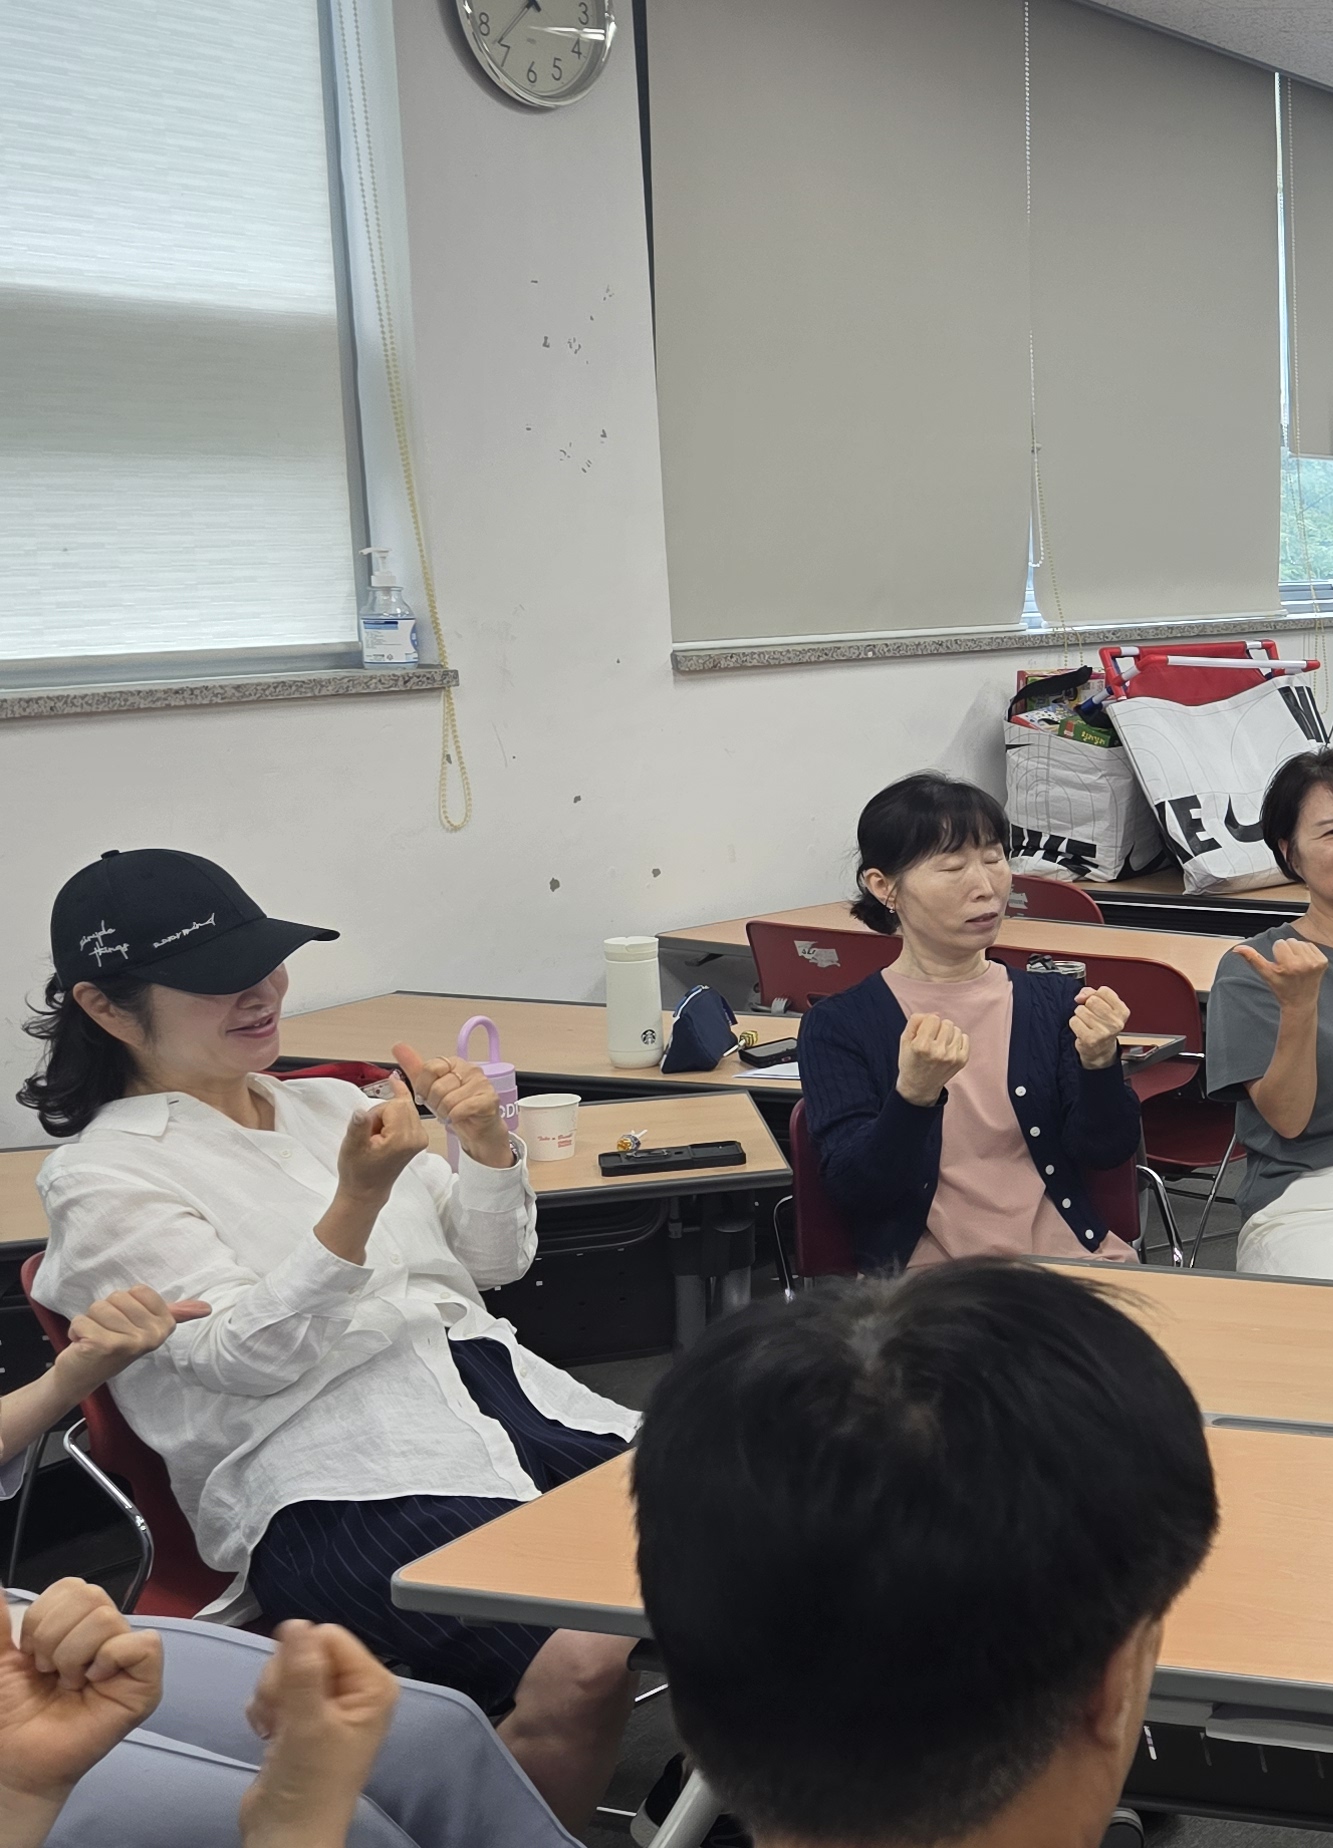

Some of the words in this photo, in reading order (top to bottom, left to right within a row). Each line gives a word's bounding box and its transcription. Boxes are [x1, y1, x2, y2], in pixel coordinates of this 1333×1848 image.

[478, 12, 490, 36] 8
[578, 2, 589, 25] 3
[571, 38, 582, 60] 4
[527, 61, 538, 84] 6
[551, 57, 562, 81] 5
